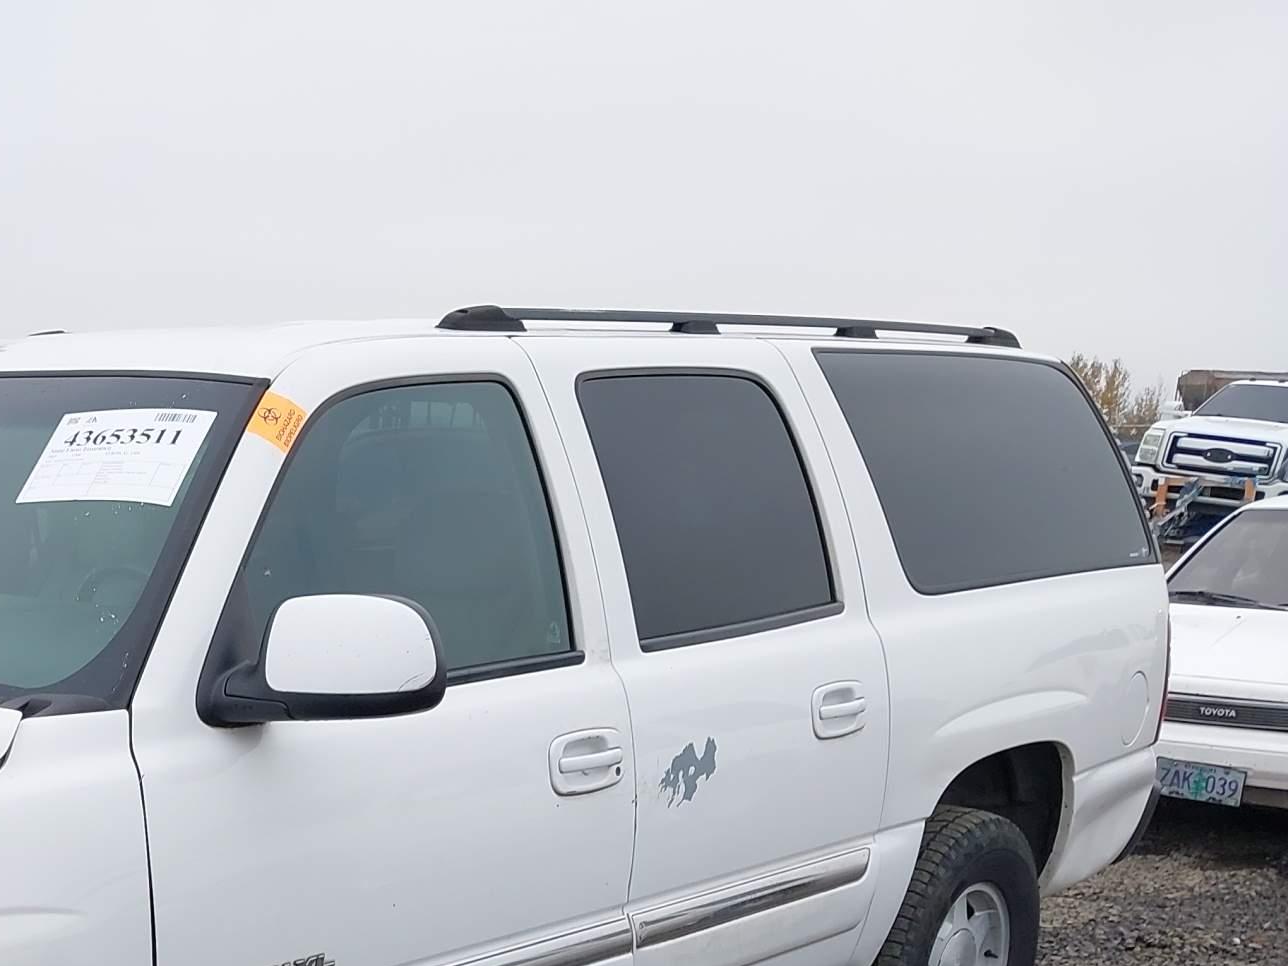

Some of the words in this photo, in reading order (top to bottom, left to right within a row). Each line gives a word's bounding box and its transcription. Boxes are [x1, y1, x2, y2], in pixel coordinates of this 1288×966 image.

[64, 428, 183, 447] 43653511
[1199, 706, 1237, 719] TOYOTA
[1159, 767, 1194, 791] ZAK
[1205, 775, 1239, 799] 039
